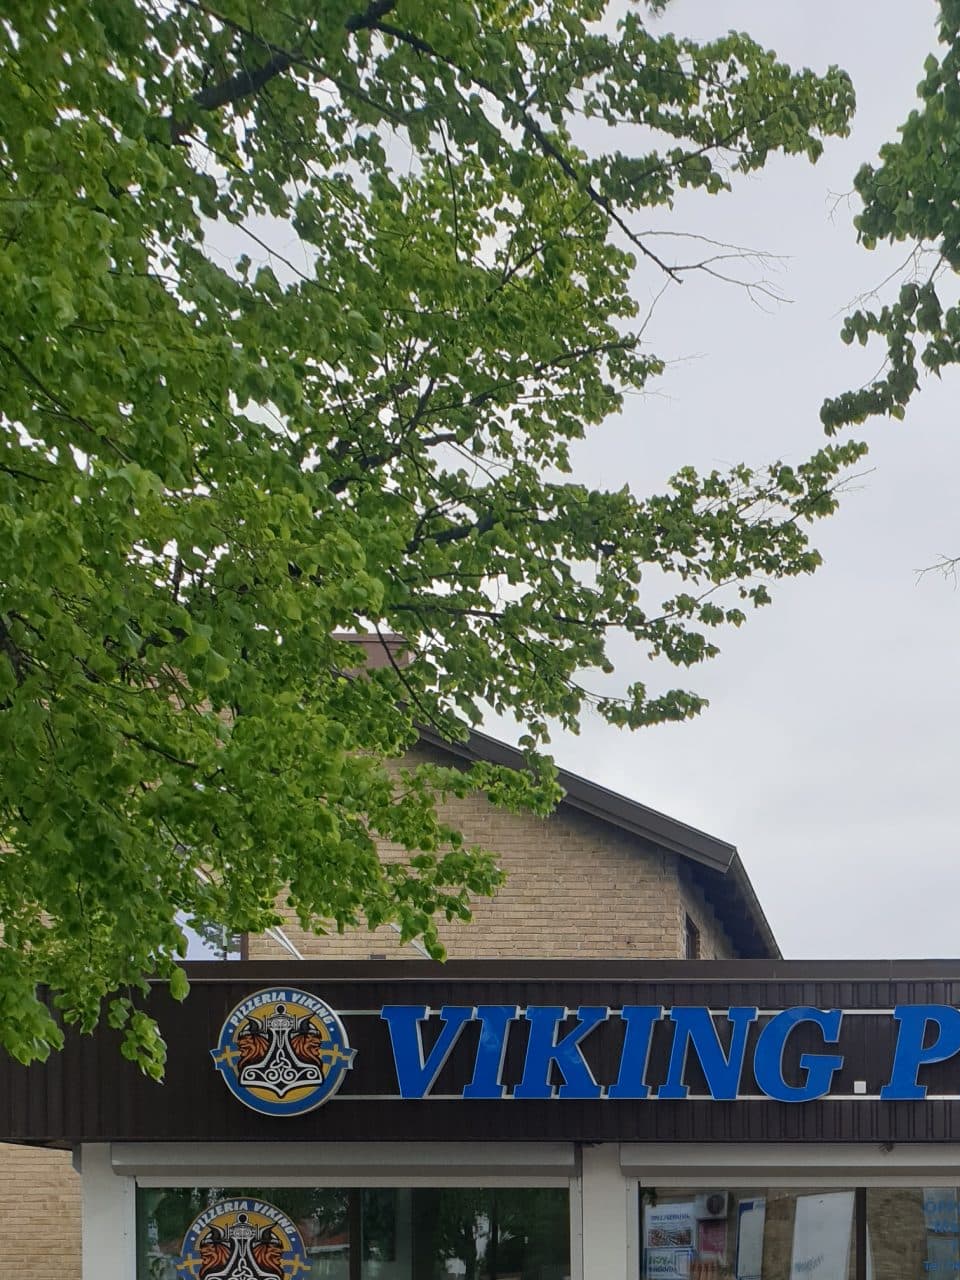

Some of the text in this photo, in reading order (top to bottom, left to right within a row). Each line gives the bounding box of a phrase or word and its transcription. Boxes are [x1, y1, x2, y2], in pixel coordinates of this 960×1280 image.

[230, 991, 335, 1027] PIZZERIA VIKING
[192, 1201, 296, 1235] PIZZERIA VIKING
